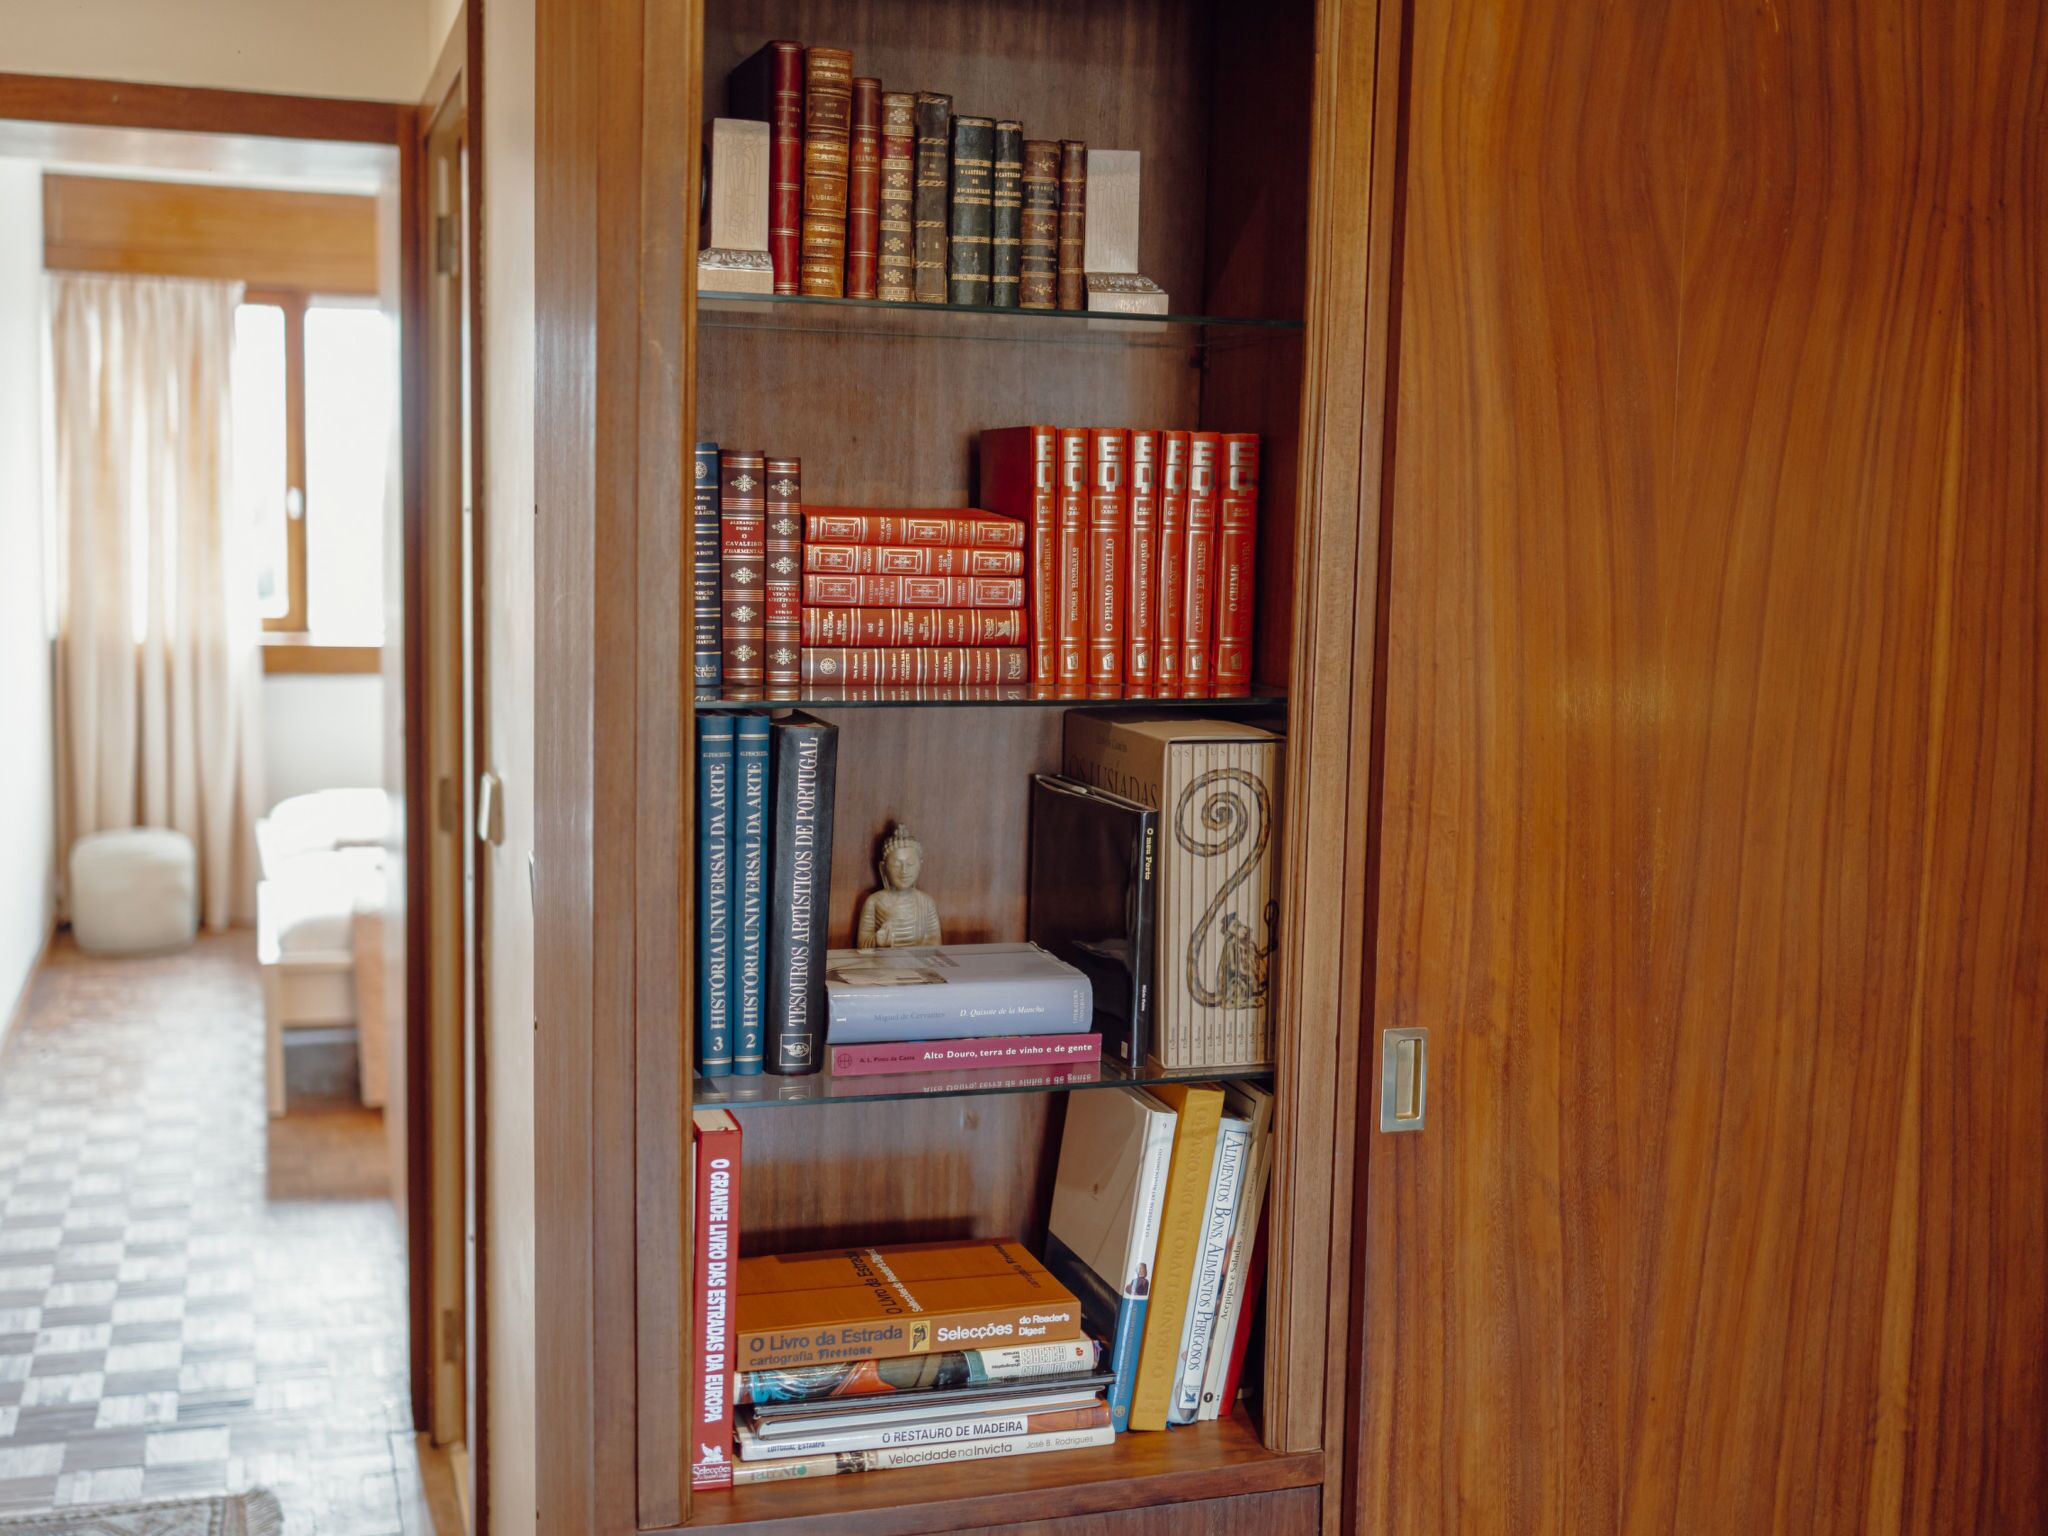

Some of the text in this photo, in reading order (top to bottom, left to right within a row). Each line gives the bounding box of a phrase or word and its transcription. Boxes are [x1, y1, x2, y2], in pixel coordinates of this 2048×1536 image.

[1104, 538, 1114, 632] O PRIMO BAZILIO
[1229, 564, 1239, 612] O CRIME
[1147, 828, 1154, 836] O
[788, 737, 818, 1027] TESOUROS ARTÍSTICOS DE PORTUGAL
[709, 763, 726, 1051] 3 HISTÓRIA UNIVERSAL DA ARTE
[742, 762, 762, 1048] 2 HISTÓRIA UNIVERSAL DA ARTE
[873, 1013, 898, 1022] Miguel
[910, 1012, 946, 1020] Cervantes
[1018, 1006, 1045, 1014] Mancha
[924, 1051, 944, 1060] Alto
[946, 1050, 978, 1060] Douro,
[980, 1048, 1002, 1057] terra
[1006, 1048, 1016, 1056] de
[1020, 1046, 1043, 1054] vinho
[1054, 1045, 1066, 1053] de
[1068, 1044, 1092, 1054] gente
[1217, 1137, 1242, 1203] ALIMENTOS
[1210, 1207, 1232, 1240] BONS,
[864, 1278, 882, 1287] da
[1200, 1242, 1226, 1308] ALIMENTOS
[1220, 1278, 1236, 1320] Acepipes
[1231, 1240, 1243, 1274] Saladas
[704, 1158, 730, 1423] O GRANDE LIVRO DAS ESTRADAS DA EUROPA
[874, 1288, 897, 1306] Livro
[1157, 1295, 1175, 1363] GRANDE
[1166, 1238, 1186, 1288] LIVRO
[1019, 1312, 1070, 1324] do Reader's
[750, 1326, 903, 1352] O Livro da Estrada
[938, 1322, 1013, 1342] Selecções
[1018, 1326, 1046, 1337] Digest
[1188, 1311, 1215, 1372] PERIGOSOS
[750, 1346, 872, 1366] cartografia Firestone
[882, 1421, 1023, 1444] O RESTAURO DE MADEIRA
[1026, 1440, 1044, 1450] José
[1055, 1436, 1094, 1447] Rodrigues
[767, 1441, 826, 1452] EDITORIAL ESTAMPA
